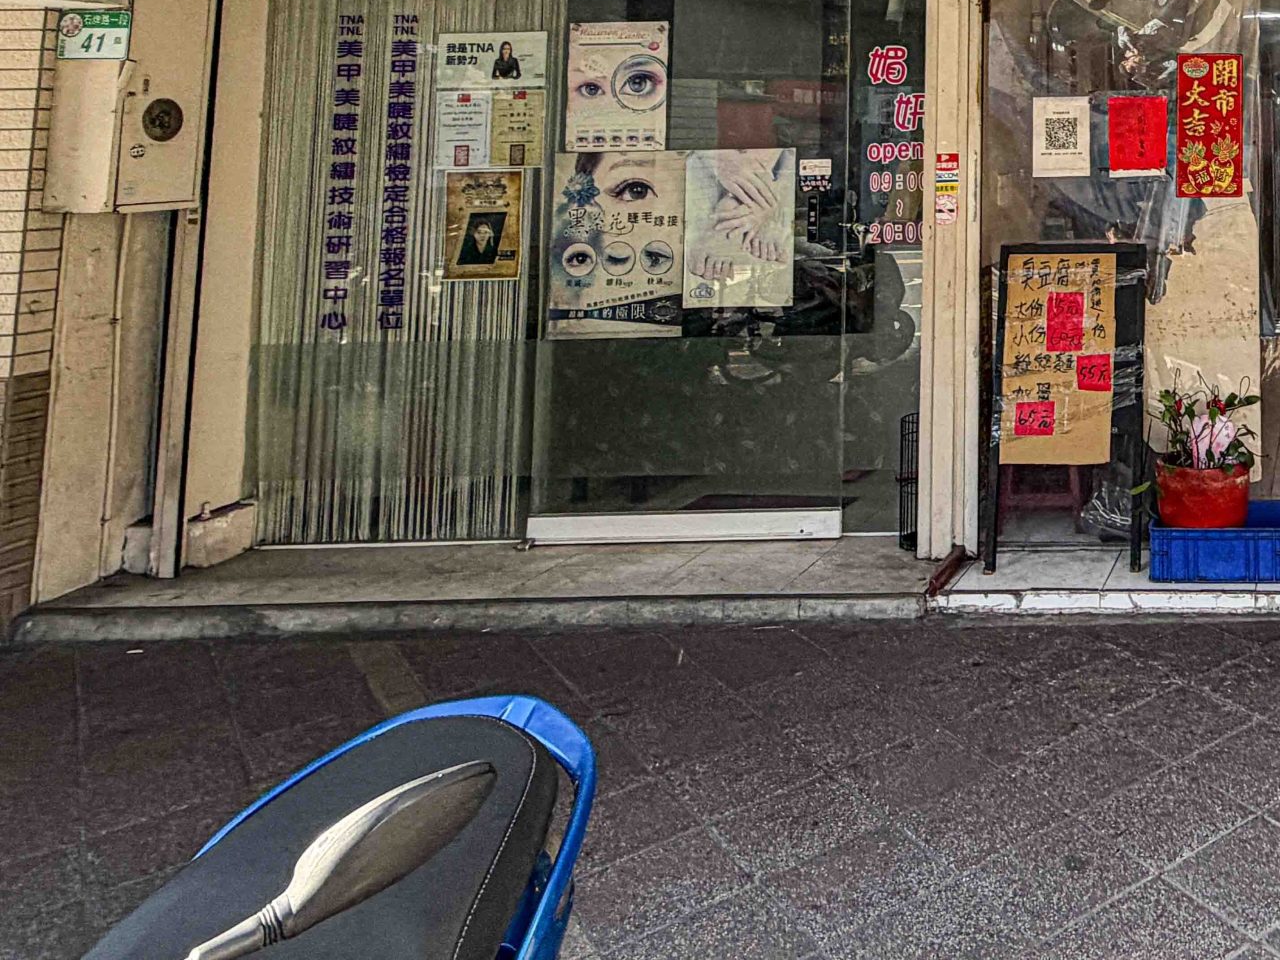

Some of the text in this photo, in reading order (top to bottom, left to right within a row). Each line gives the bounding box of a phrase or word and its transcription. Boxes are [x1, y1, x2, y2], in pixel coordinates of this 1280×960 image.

[339, 15, 365, 25] TNA
[394, 14, 419, 24] TNA
[81, 33, 106, 53] 41
[867, 141, 924, 164] open
